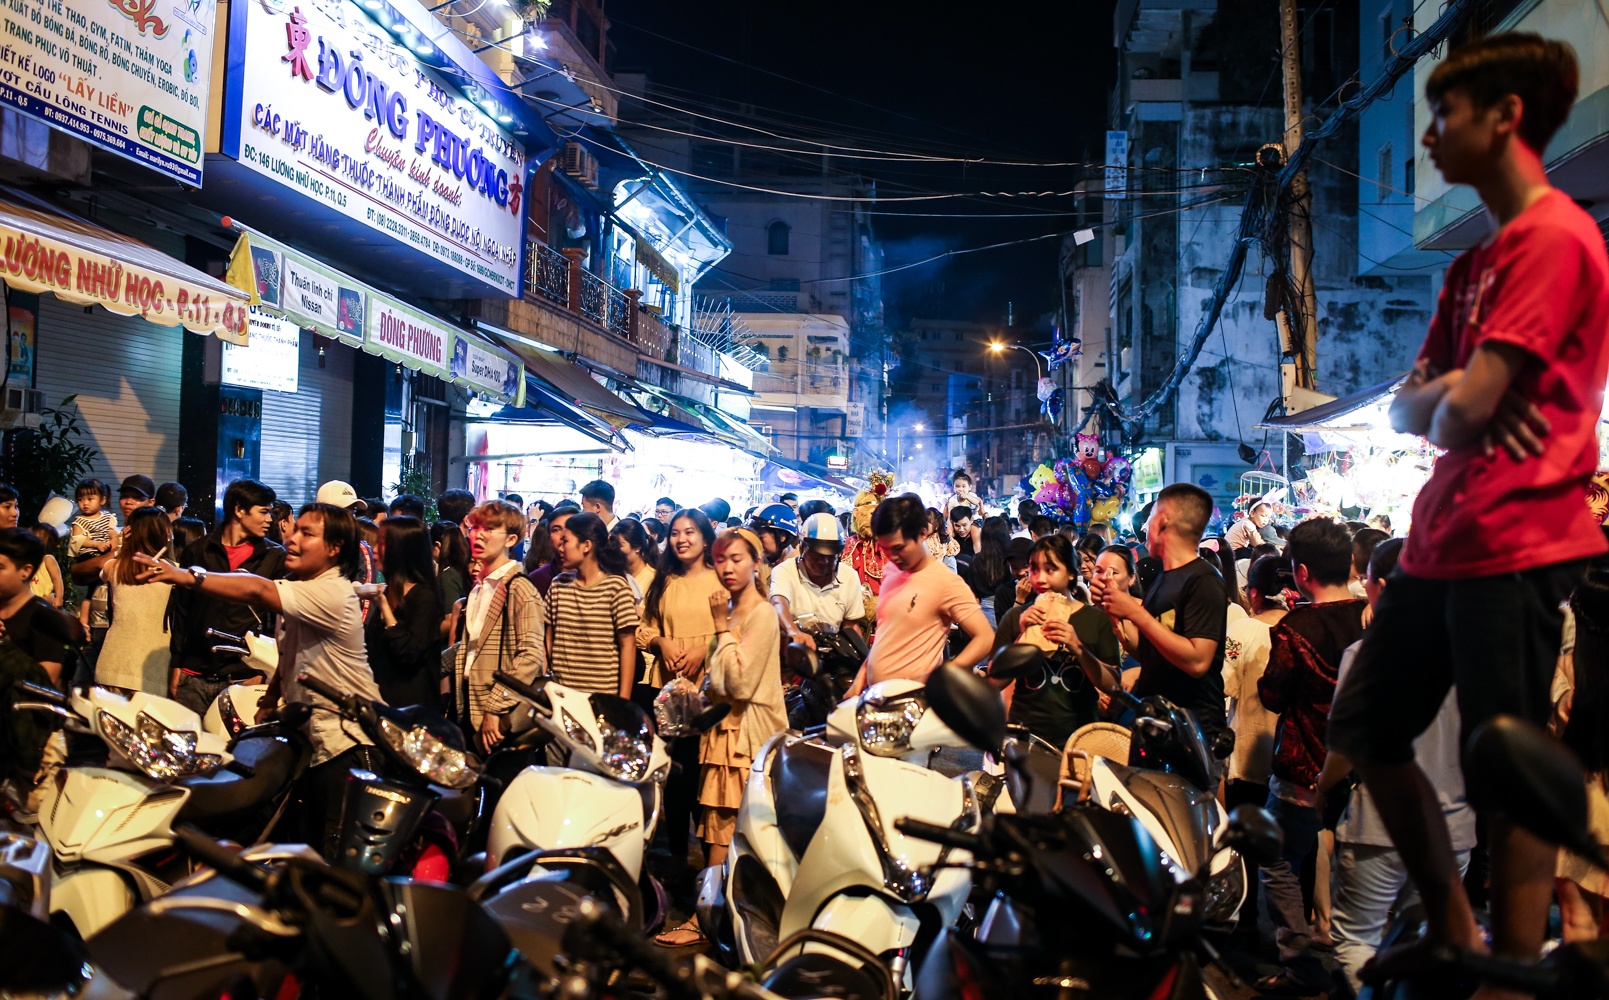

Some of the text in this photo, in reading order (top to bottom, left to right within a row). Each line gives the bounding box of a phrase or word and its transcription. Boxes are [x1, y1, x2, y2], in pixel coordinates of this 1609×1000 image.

[0, 44, 16, 65] IẾT
[18, 54, 32, 72] KẾ
[33, 62, 56, 84] LOGO
[4, 18, 98, 78] TRANG PHỤC VÕ THUẬT
[44, 16, 64, 37] BÓNG
[65, 27, 77, 46] ĐÁ,
[79, 34, 98, 55] BÓNG
[112, 52, 130, 71] BÓNG
[158, 76, 180, 100] EROBIC,
[66, 7, 88, 32] THAO,
[91, 21, 108, 43] GYM,
[111, 32, 132, 56] FATIN,
[135, 46, 154, 66] THẢM
[156, 57, 172, 76] YOGA
[281, 6, 314, 83] 東
[0, 68, 128, 135] ỢT CẦU LÔNG TENNIS
[316, 35, 510, 208] ĐÔNG PHƯƠNG
[427, 82, 457, 116] HỌC
[479, 123, 525, 168] TRUYỀN
[244, 143, 258, 163] ĐC:
[259, 152, 270, 169] 146
[271, 158, 295, 182] LƯƠNG
[295, 170, 310, 188] NHỮ
[310, 178, 324, 197] HỌC
[337, 192, 347, 208] Q.5
[253, 103, 281, 137] CÁC
[283, 120, 308, 152] MẶT
[309, 134, 340, 170] HÀNG
[341, 153, 375, 188] THUỐC
[375, 173, 405, 206] THÀNH
[406, 190, 430, 220] PHẨM
[428, 203, 451, 231] ĐÔNG
[450, 217, 471, 243] DƯỢC
[364, 127, 406, 172] Chuyên
[408, 157, 431, 188] kinh
[0, 232, 72, 291] ƯƠNG
[77, 257, 124, 303] NHỮ
[125, 271, 165, 319] HỌC
[177, 287, 211, 327] P.11
[301, 294, 322, 315] Nissan
[312, 280, 323, 298] linh
[324, 288, 333, 302] chi
[380, 308, 406, 349] ĐÔNG
[408, 324, 442, 363] PHƯƠNG
[472, 360, 484, 378] Super
